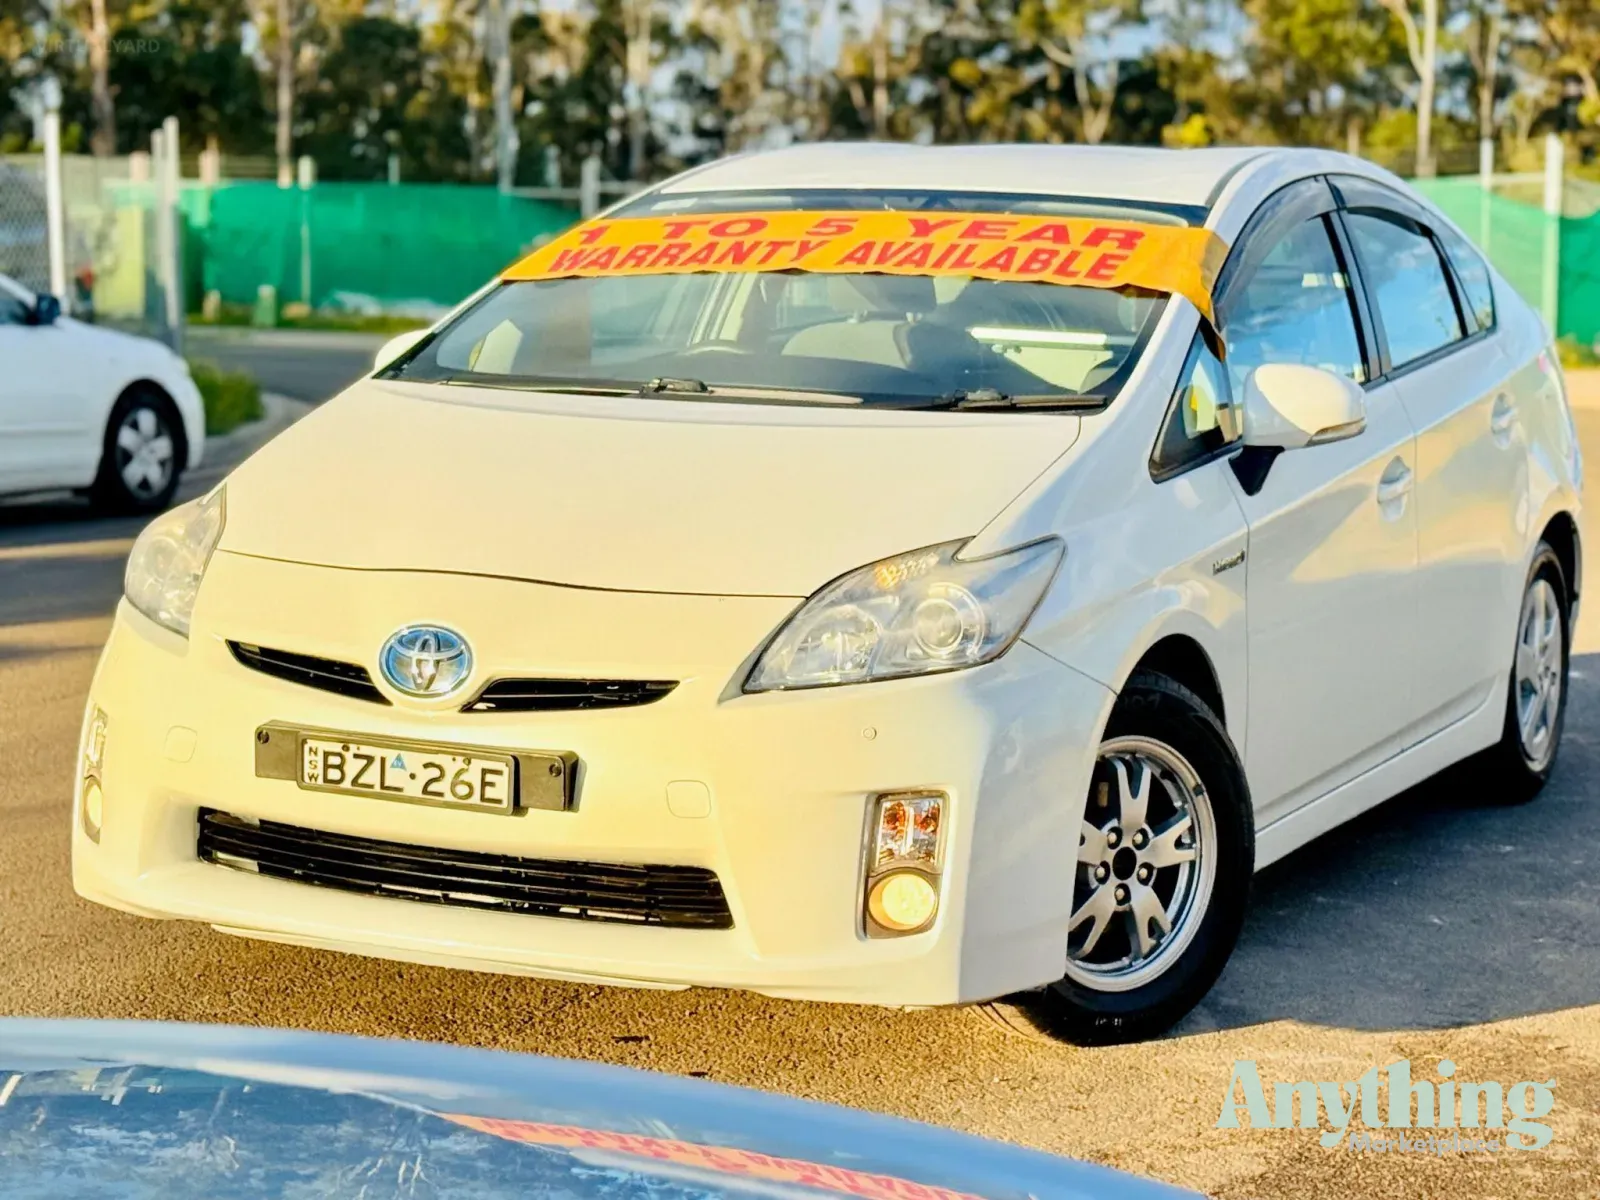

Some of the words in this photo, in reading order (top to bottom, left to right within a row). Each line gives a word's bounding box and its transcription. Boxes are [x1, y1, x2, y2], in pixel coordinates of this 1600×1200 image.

[579, 225, 611, 245] 1
[662, 218, 769, 241] TO
[805, 218, 860, 237] 5
[907, 218, 1146, 251] YEAR
[547, 240, 831, 273] WARRANTY
[835, 241, 1130, 281] AVAILABLE
